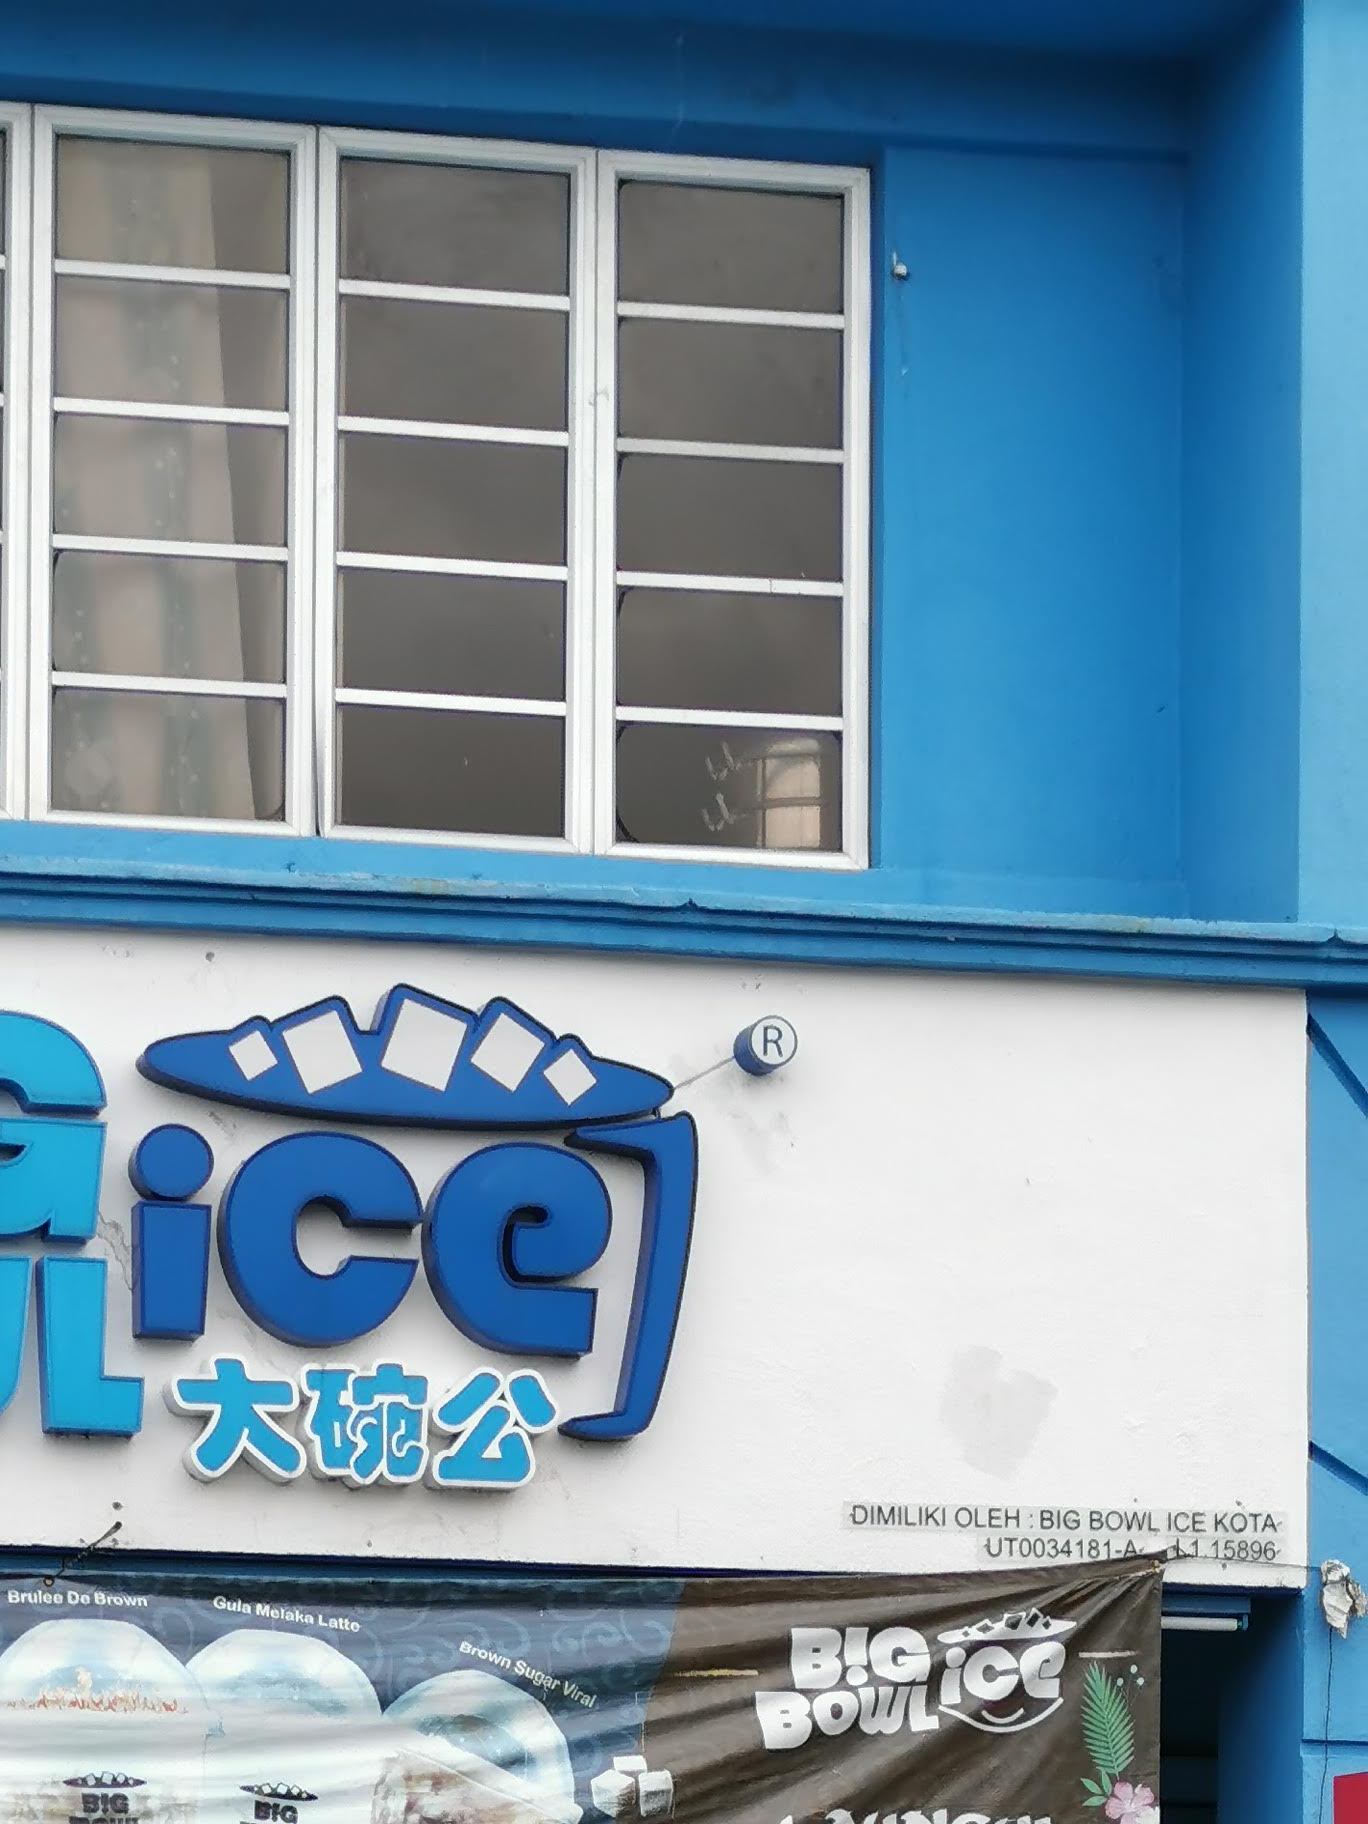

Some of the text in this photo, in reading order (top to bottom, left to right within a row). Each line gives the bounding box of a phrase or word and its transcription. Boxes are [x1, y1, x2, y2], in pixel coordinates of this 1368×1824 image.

[169, 1353, 560, 1488] 大碗公
[851, 1504, 946, 1527] DIMILIKI
[954, 1506, 1020, 1529] OLEH
[1039, 1509, 1081, 1530] BIG
[1088, 1510, 1160, 1532] BOWL
[1167, 1511, 1207, 1533] ICE
[1213, 1512, 1278, 1533] KOTA
[986, 1536, 1139, 1559] UT0034181-A
[7, 1589, 148, 1608] Brulee De Brown
[213, 1595, 361, 1633] Gula Melaka Latte
[458, 1640, 598, 1708] Brown Sugar Viral
[754, 1684, 940, 1750] BOWL
